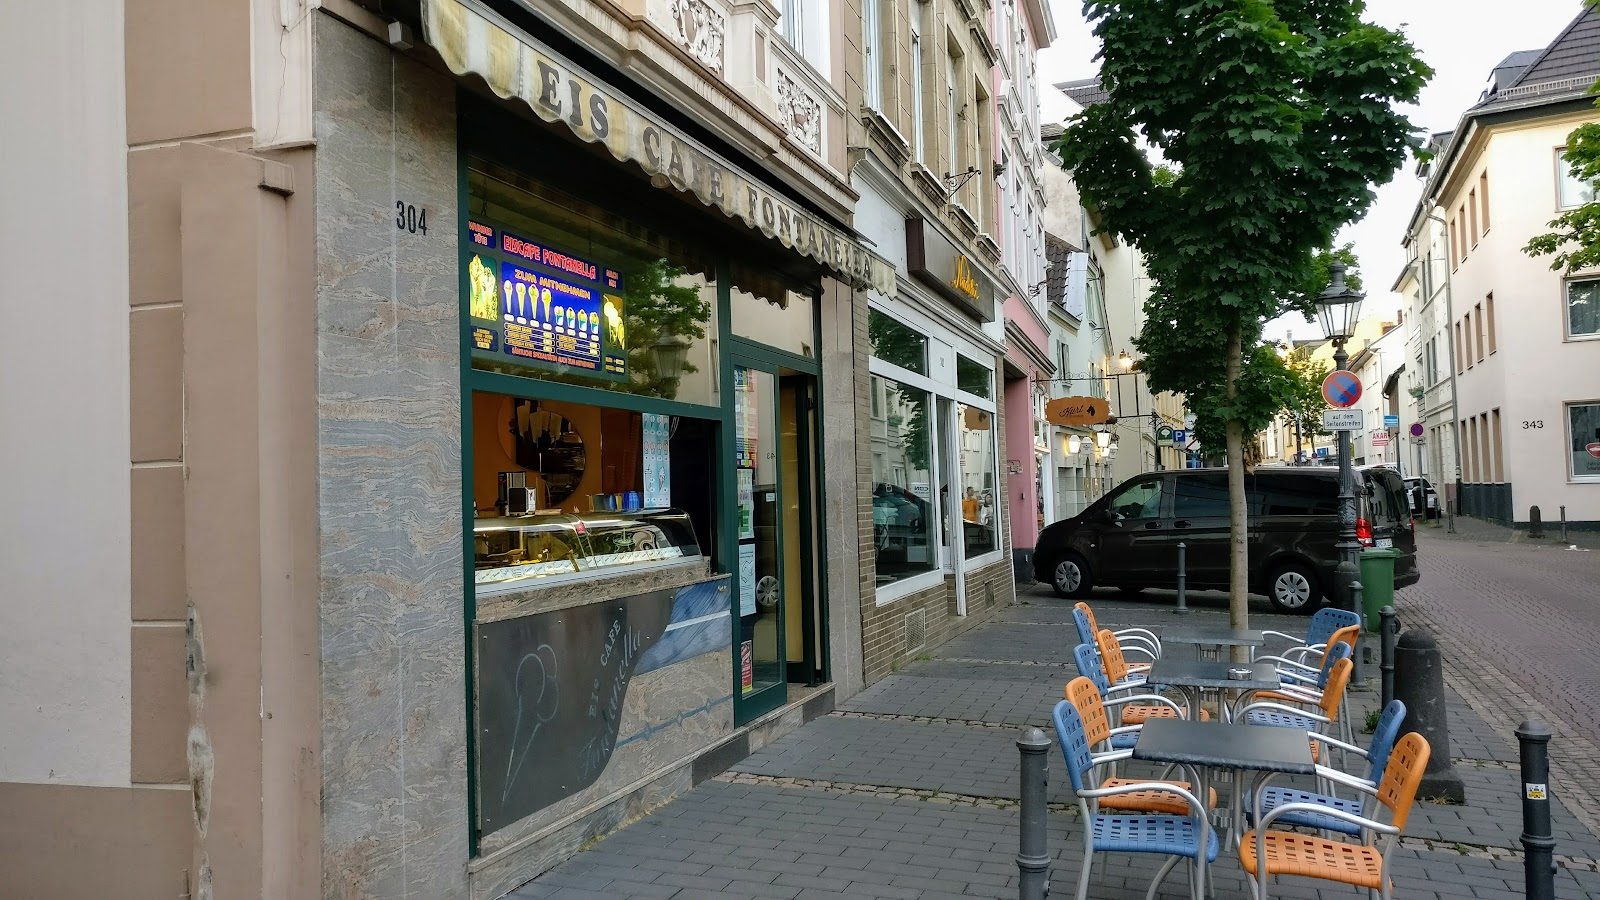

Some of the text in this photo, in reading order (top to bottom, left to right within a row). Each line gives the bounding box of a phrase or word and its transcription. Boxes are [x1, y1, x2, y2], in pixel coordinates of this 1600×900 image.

[537, 59, 609, 139] EIS
[643, 126, 724, 203] CAFE
[396, 200, 427, 236] 304
[1372, 432, 1388, 440] AKAR
[1522, 420, 1544, 430] 343
[600, 619, 622, 668] CAFE
